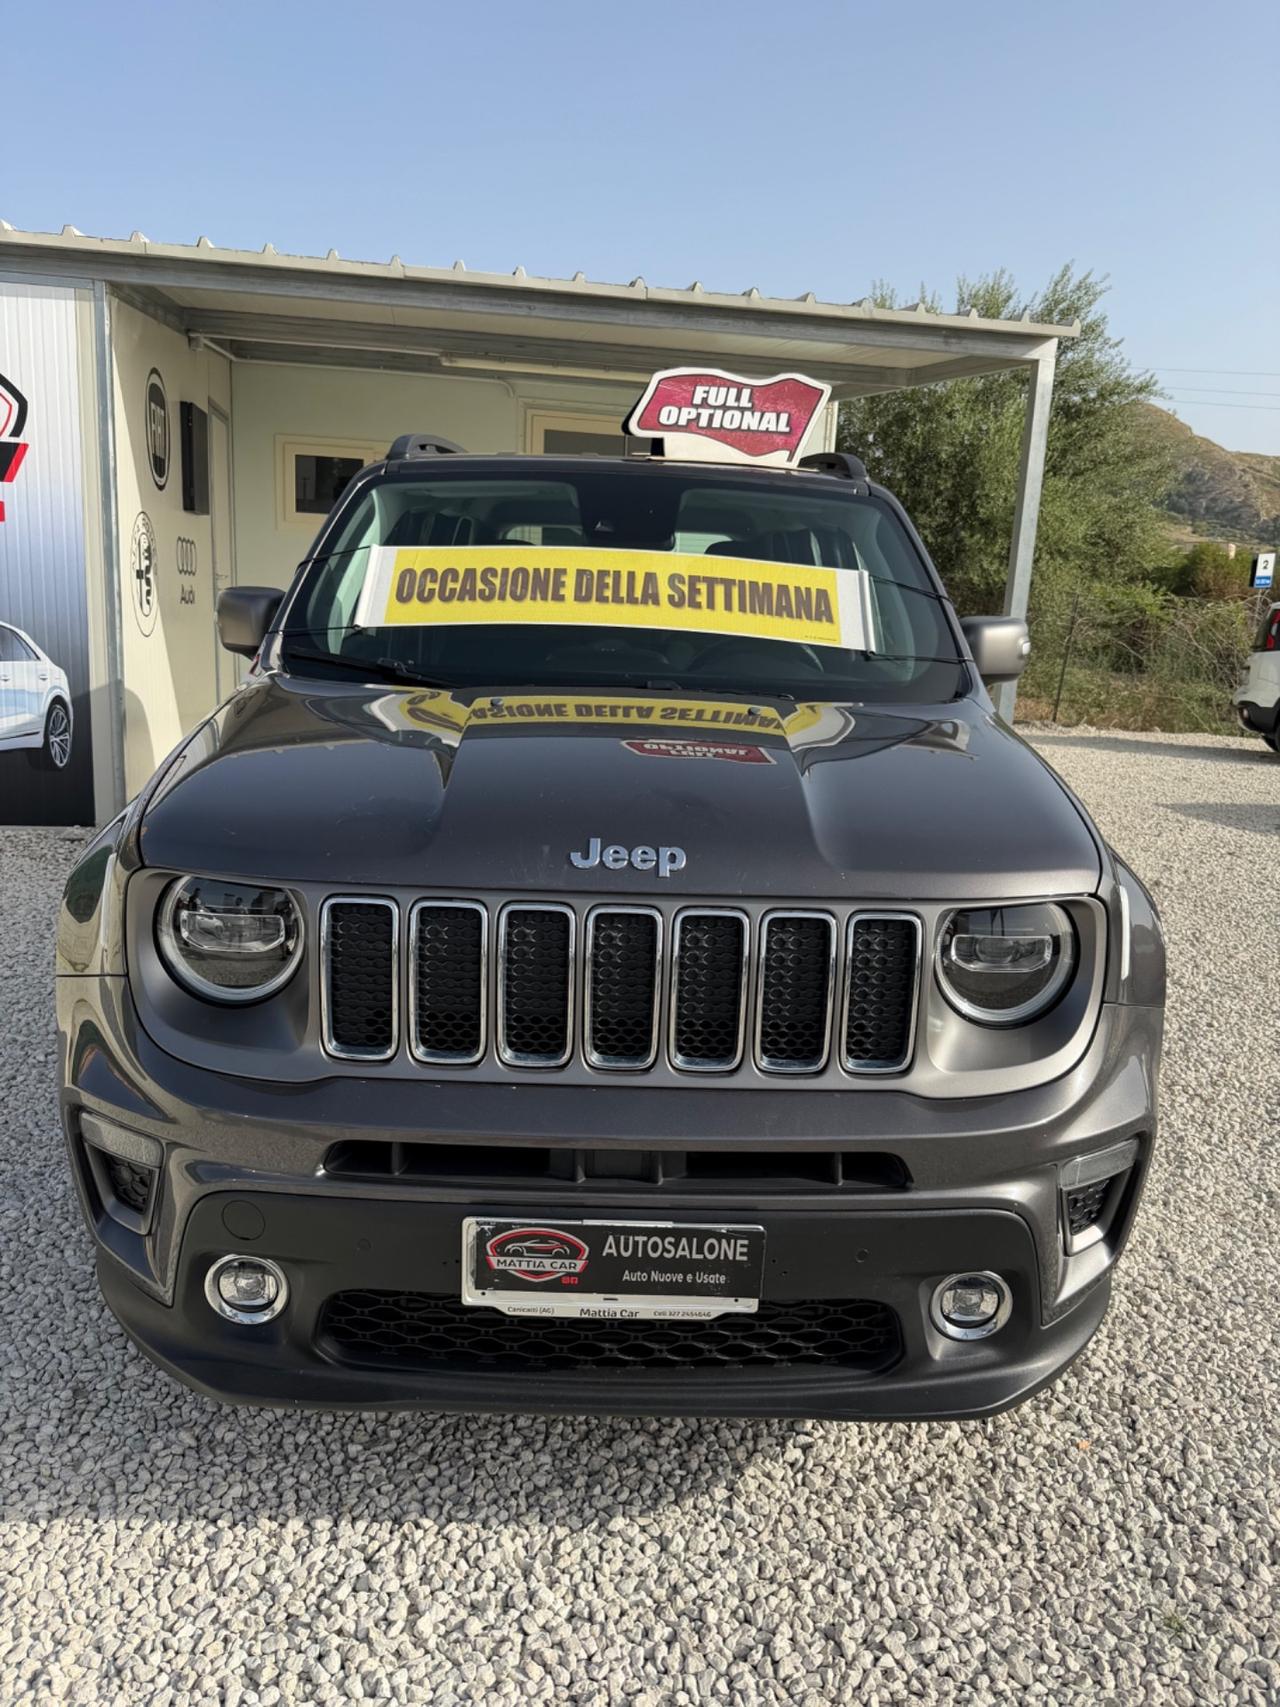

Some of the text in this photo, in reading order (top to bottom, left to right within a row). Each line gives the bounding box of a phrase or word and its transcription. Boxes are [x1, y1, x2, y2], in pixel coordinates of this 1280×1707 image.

[692, 385, 753, 408] FULL
[658, 405, 791, 433] OPTIONAL
[1262, 559, 1270, 570] 2
[395, 566, 835, 624] OCCASIONE DELLA SETTIMANA
[569, 837, 687, 878] Jeep
[602, 1234, 749, 1261] AUTOSALONE
[496, 1258, 578, 1271] MATTIA CAR
[622, 1269, 649, 1282] Auto
[650, 1270, 684, 1283] Nuove
[686, 1273, 693, 1283] e
[579, 1308, 640, 1318] Mattia Car
